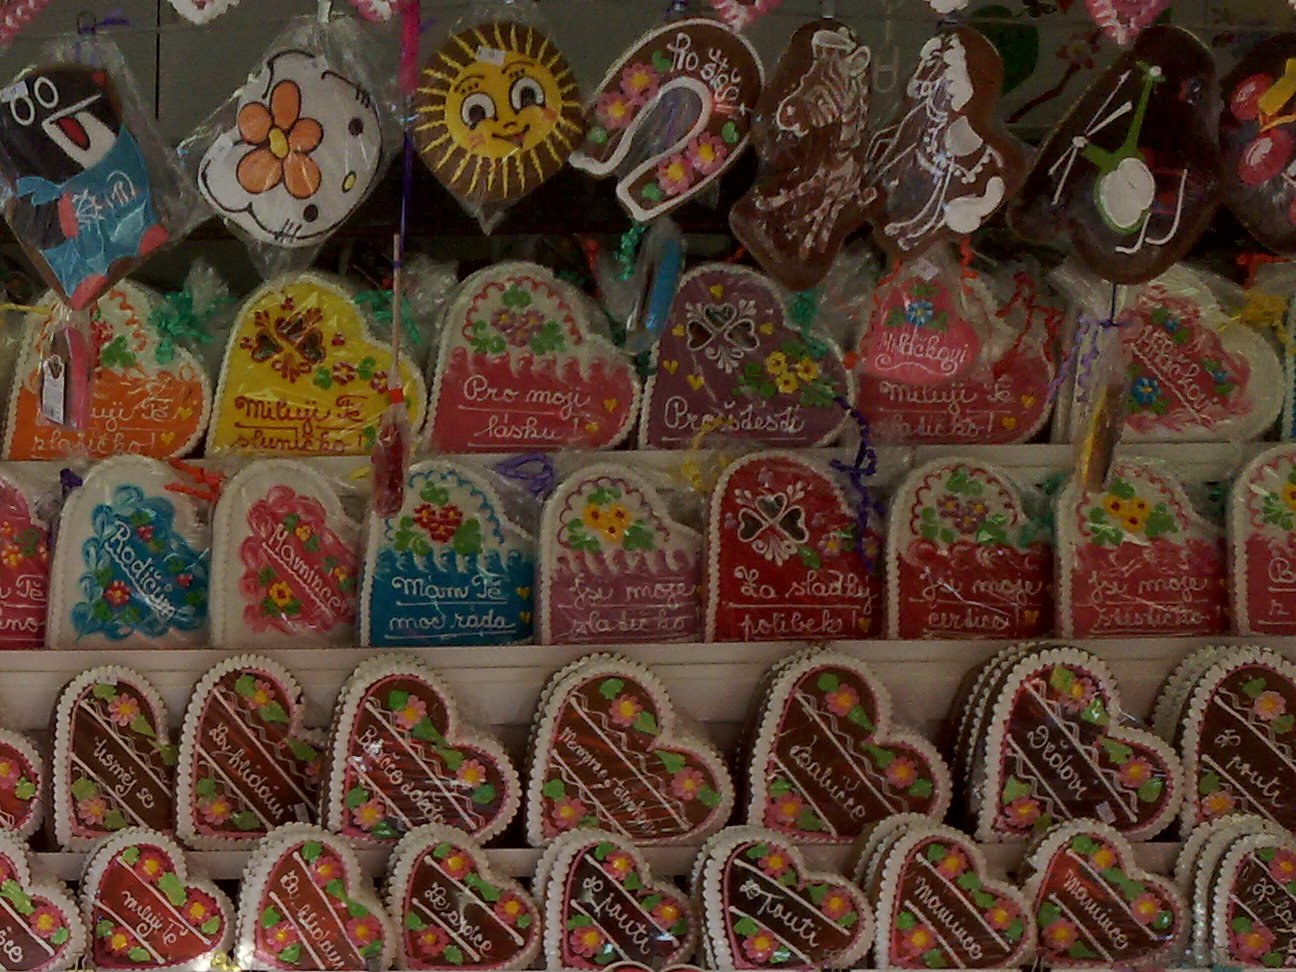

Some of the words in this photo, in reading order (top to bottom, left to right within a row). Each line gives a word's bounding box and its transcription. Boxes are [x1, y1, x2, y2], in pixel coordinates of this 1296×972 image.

[464, 375, 518, 402] Pro
[526, 386, 590, 419] moji
[235, 396, 331, 434] Miluji
[15, 576, 45, 601] Tě
[392, 575, 468, 599] Mám
[472, 573, 503, 599] Tě
[136, 785, 156, 809] se
